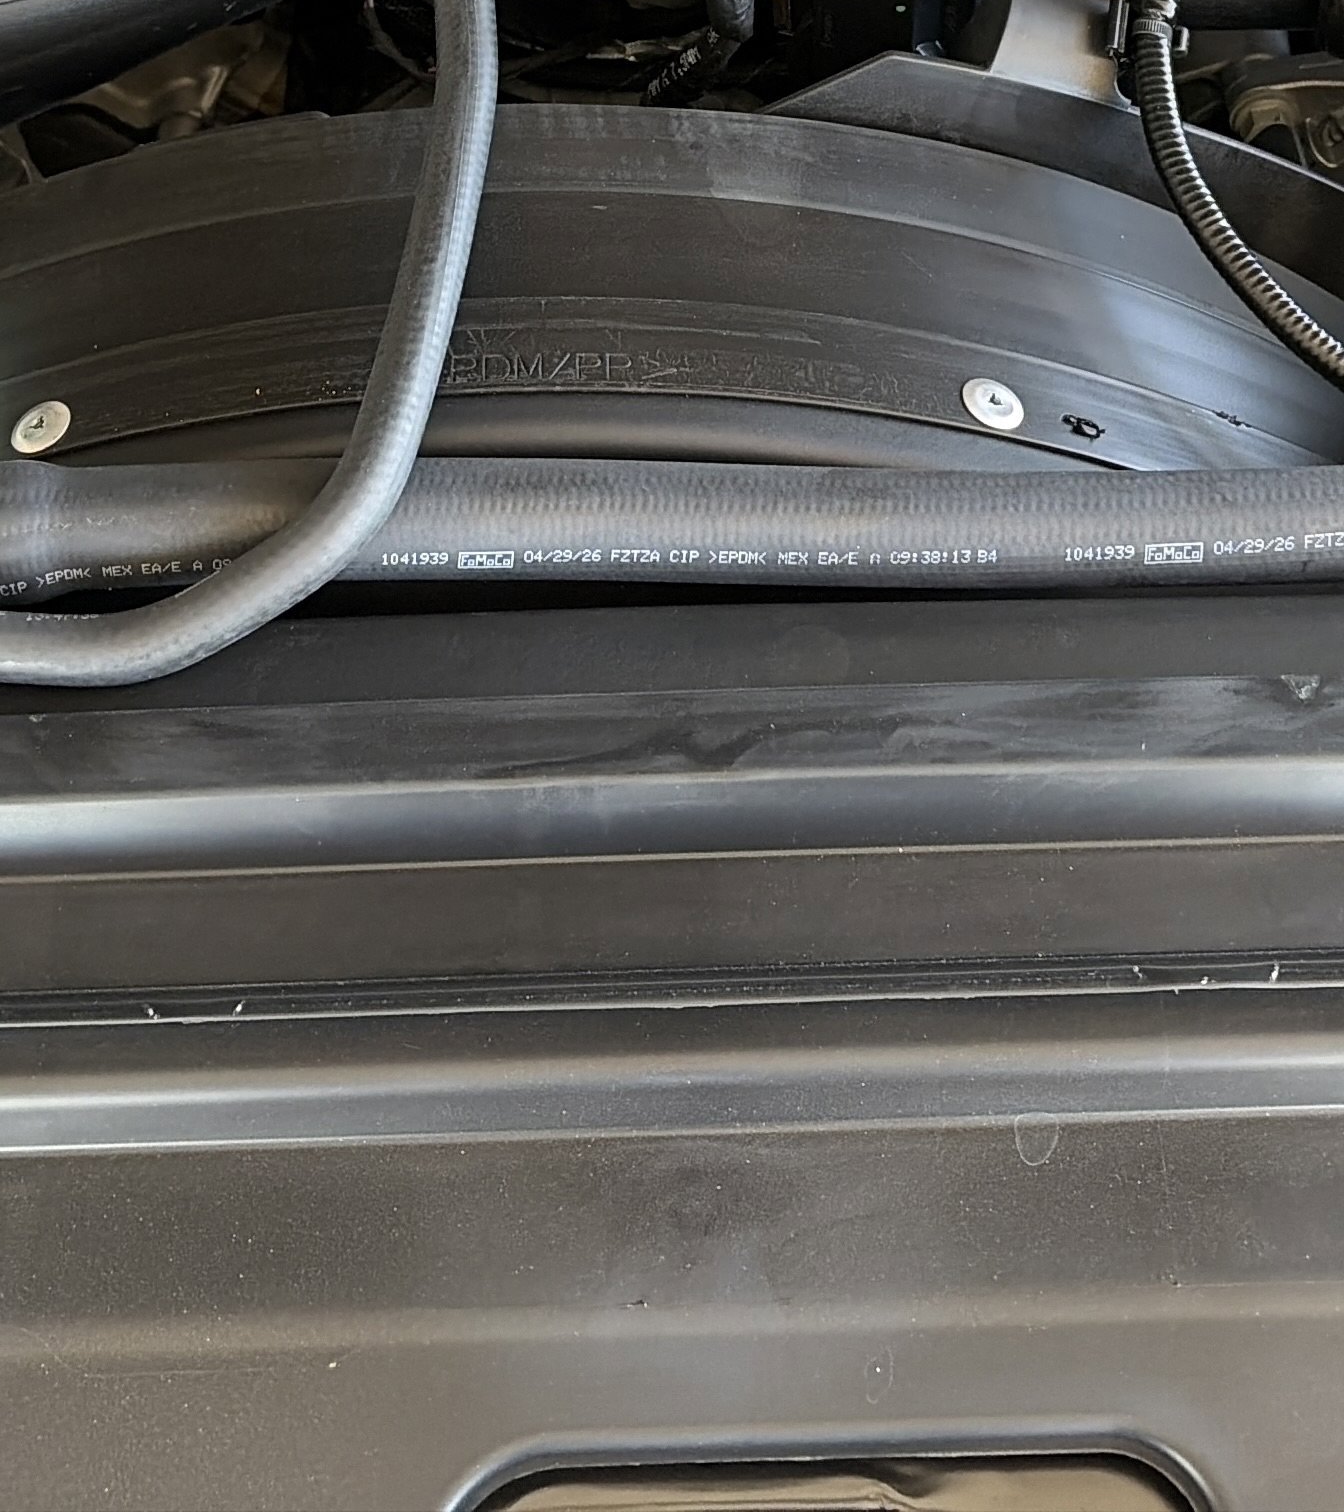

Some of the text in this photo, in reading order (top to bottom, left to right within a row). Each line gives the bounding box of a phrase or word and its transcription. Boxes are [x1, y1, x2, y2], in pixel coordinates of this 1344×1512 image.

[381, 549, 999, 567] 1041939 FoMoCo 04/29/26 FZTZA CIP >EPDM< MEX EA/E A 09:38:13 B4
[1064, 545, 1136, 562] 1041939
[1146, 545, 1201, 562] FoMoCo
[1213, 535, 1296, 555] 04/29/26
[0, 581, 29, 599] CIP
[102, 564, 134, 577] MEX
[141, 560, 182, 575] EA/E
[192, 560, 203, 572] A
